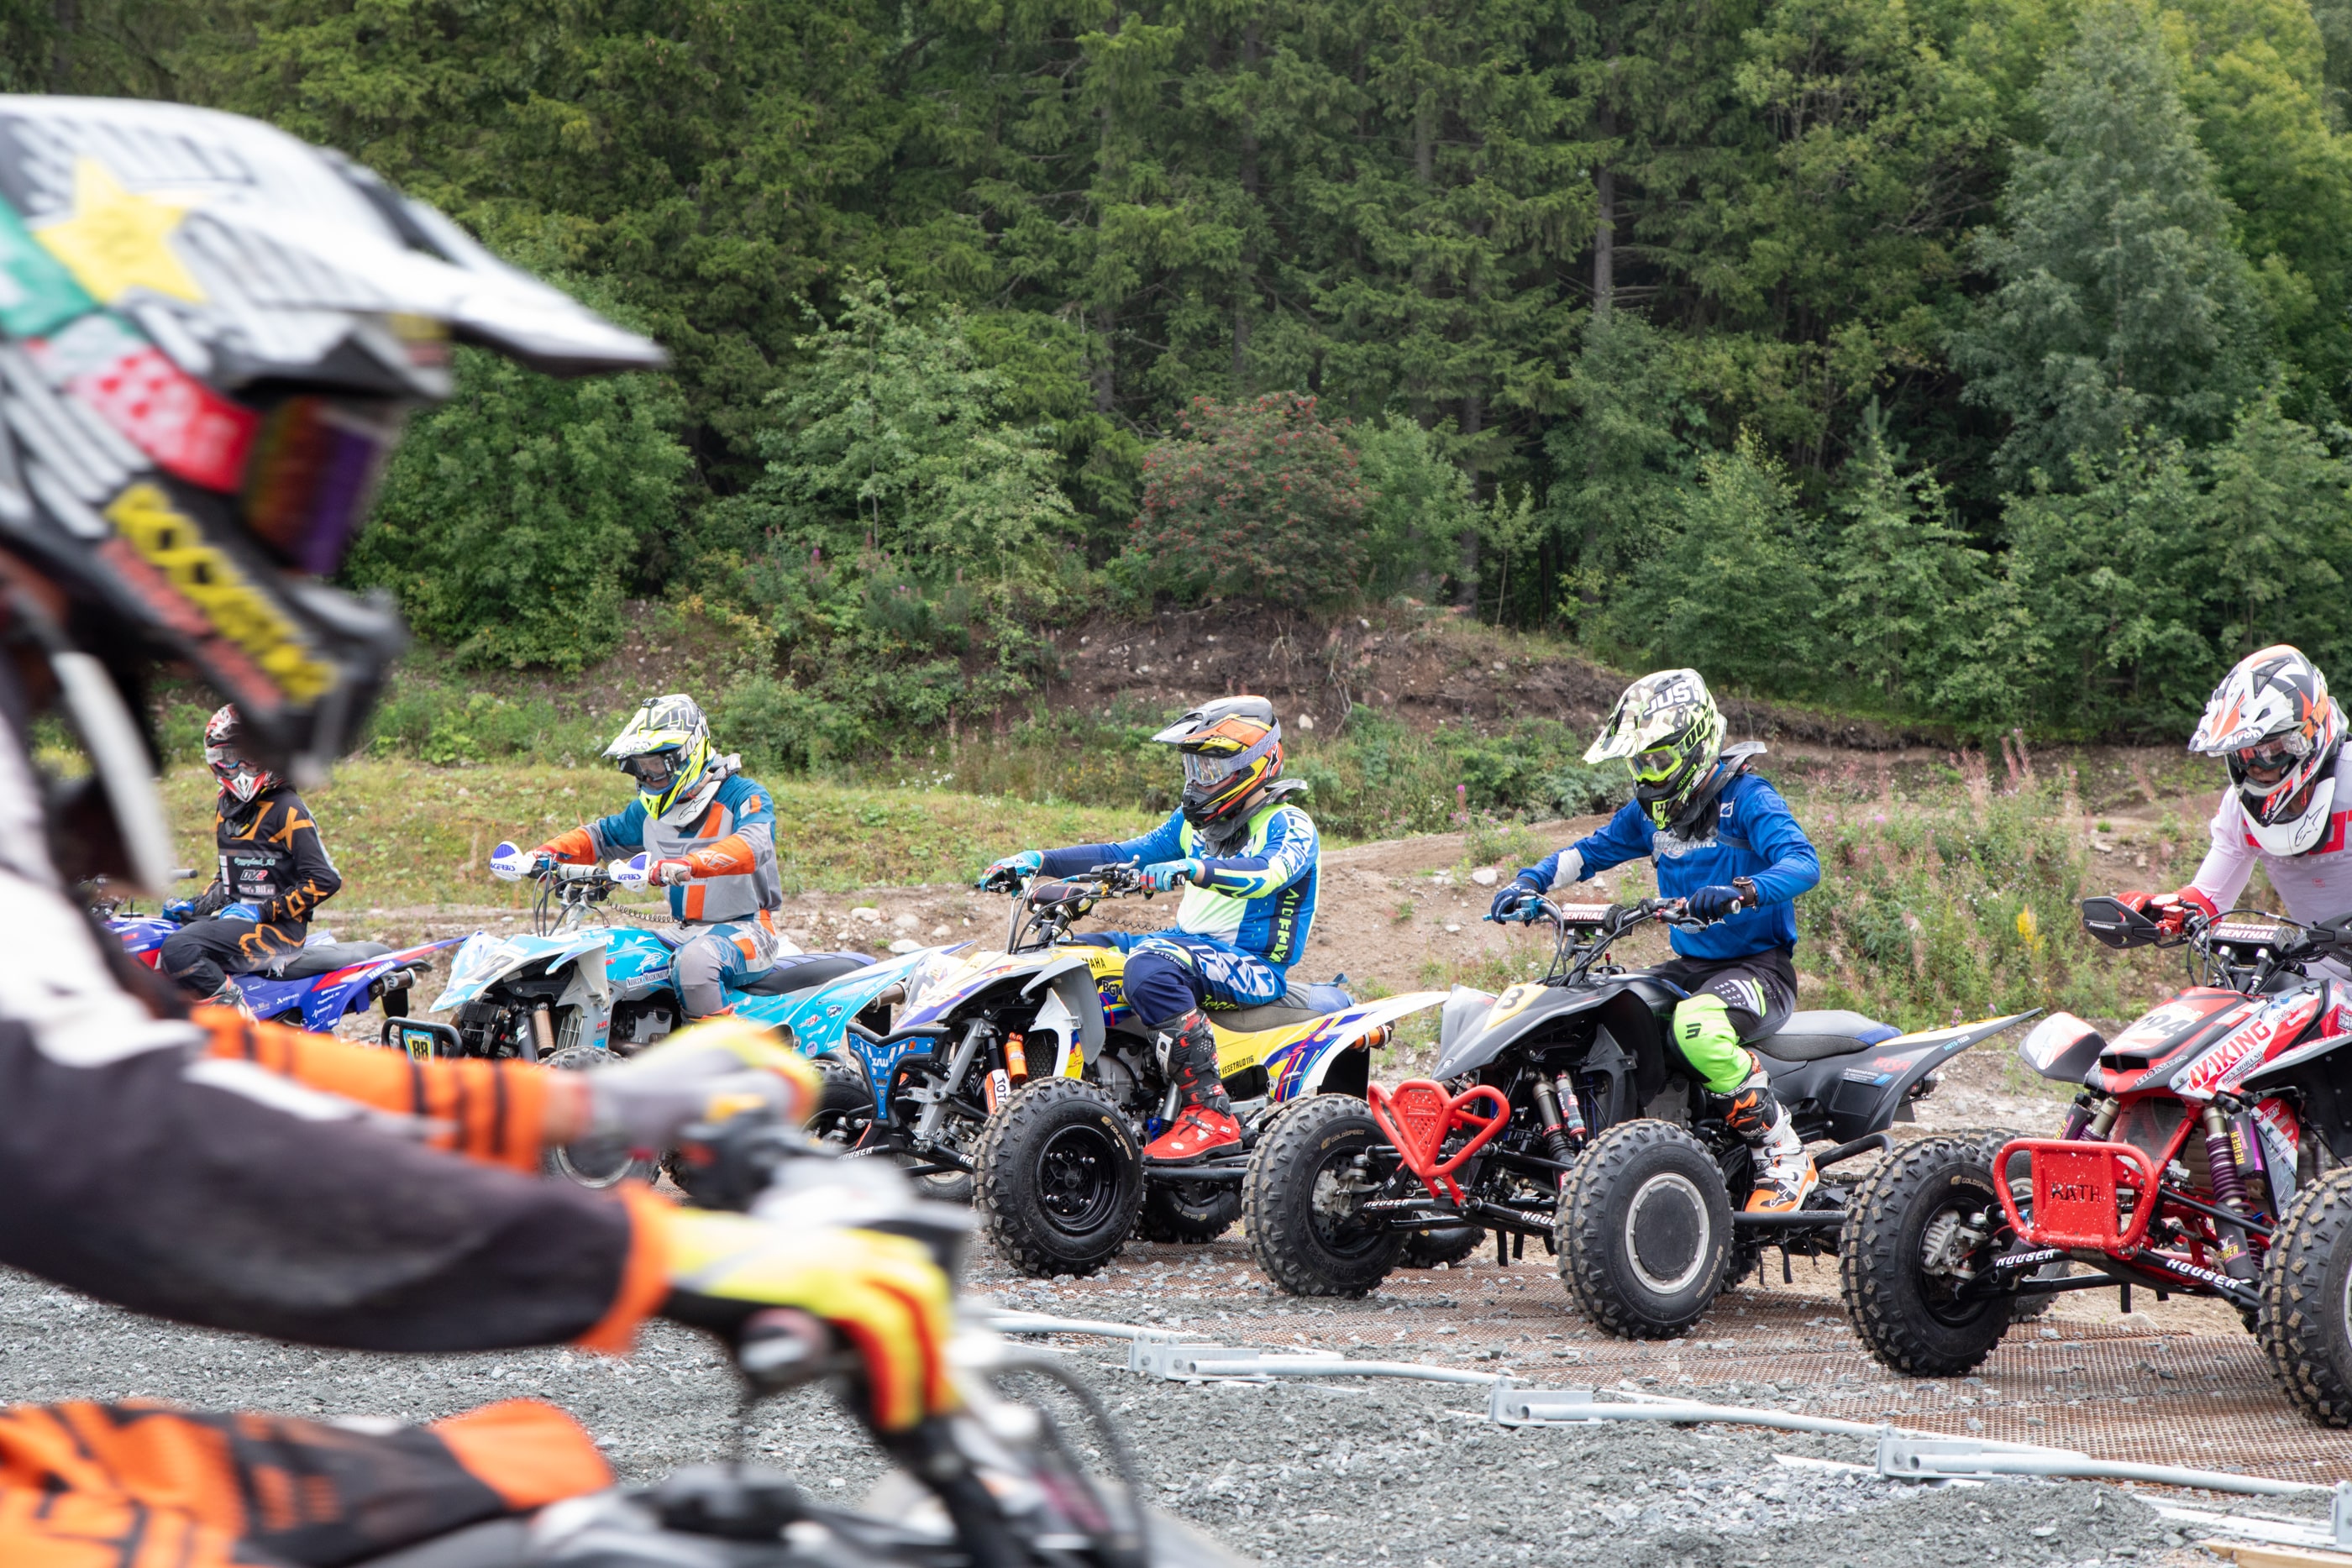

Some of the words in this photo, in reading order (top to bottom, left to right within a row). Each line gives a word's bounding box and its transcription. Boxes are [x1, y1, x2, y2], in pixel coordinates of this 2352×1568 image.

[2214, 929, 2276, 940] RENTHAL
[367, 960, 396, 980] YAMAHA
[412, 1040, 429, 1062] 88
[2194, 1019, 2271, 1085] VIKING
[2135, 1055, 2188, 1087] HONDA
[2230, 1130, 2245, 1166] REIGER
[1996, 1249, 2056, 1267] HOUSER
[2166, 1258, 2241, 1291] HOUSER
